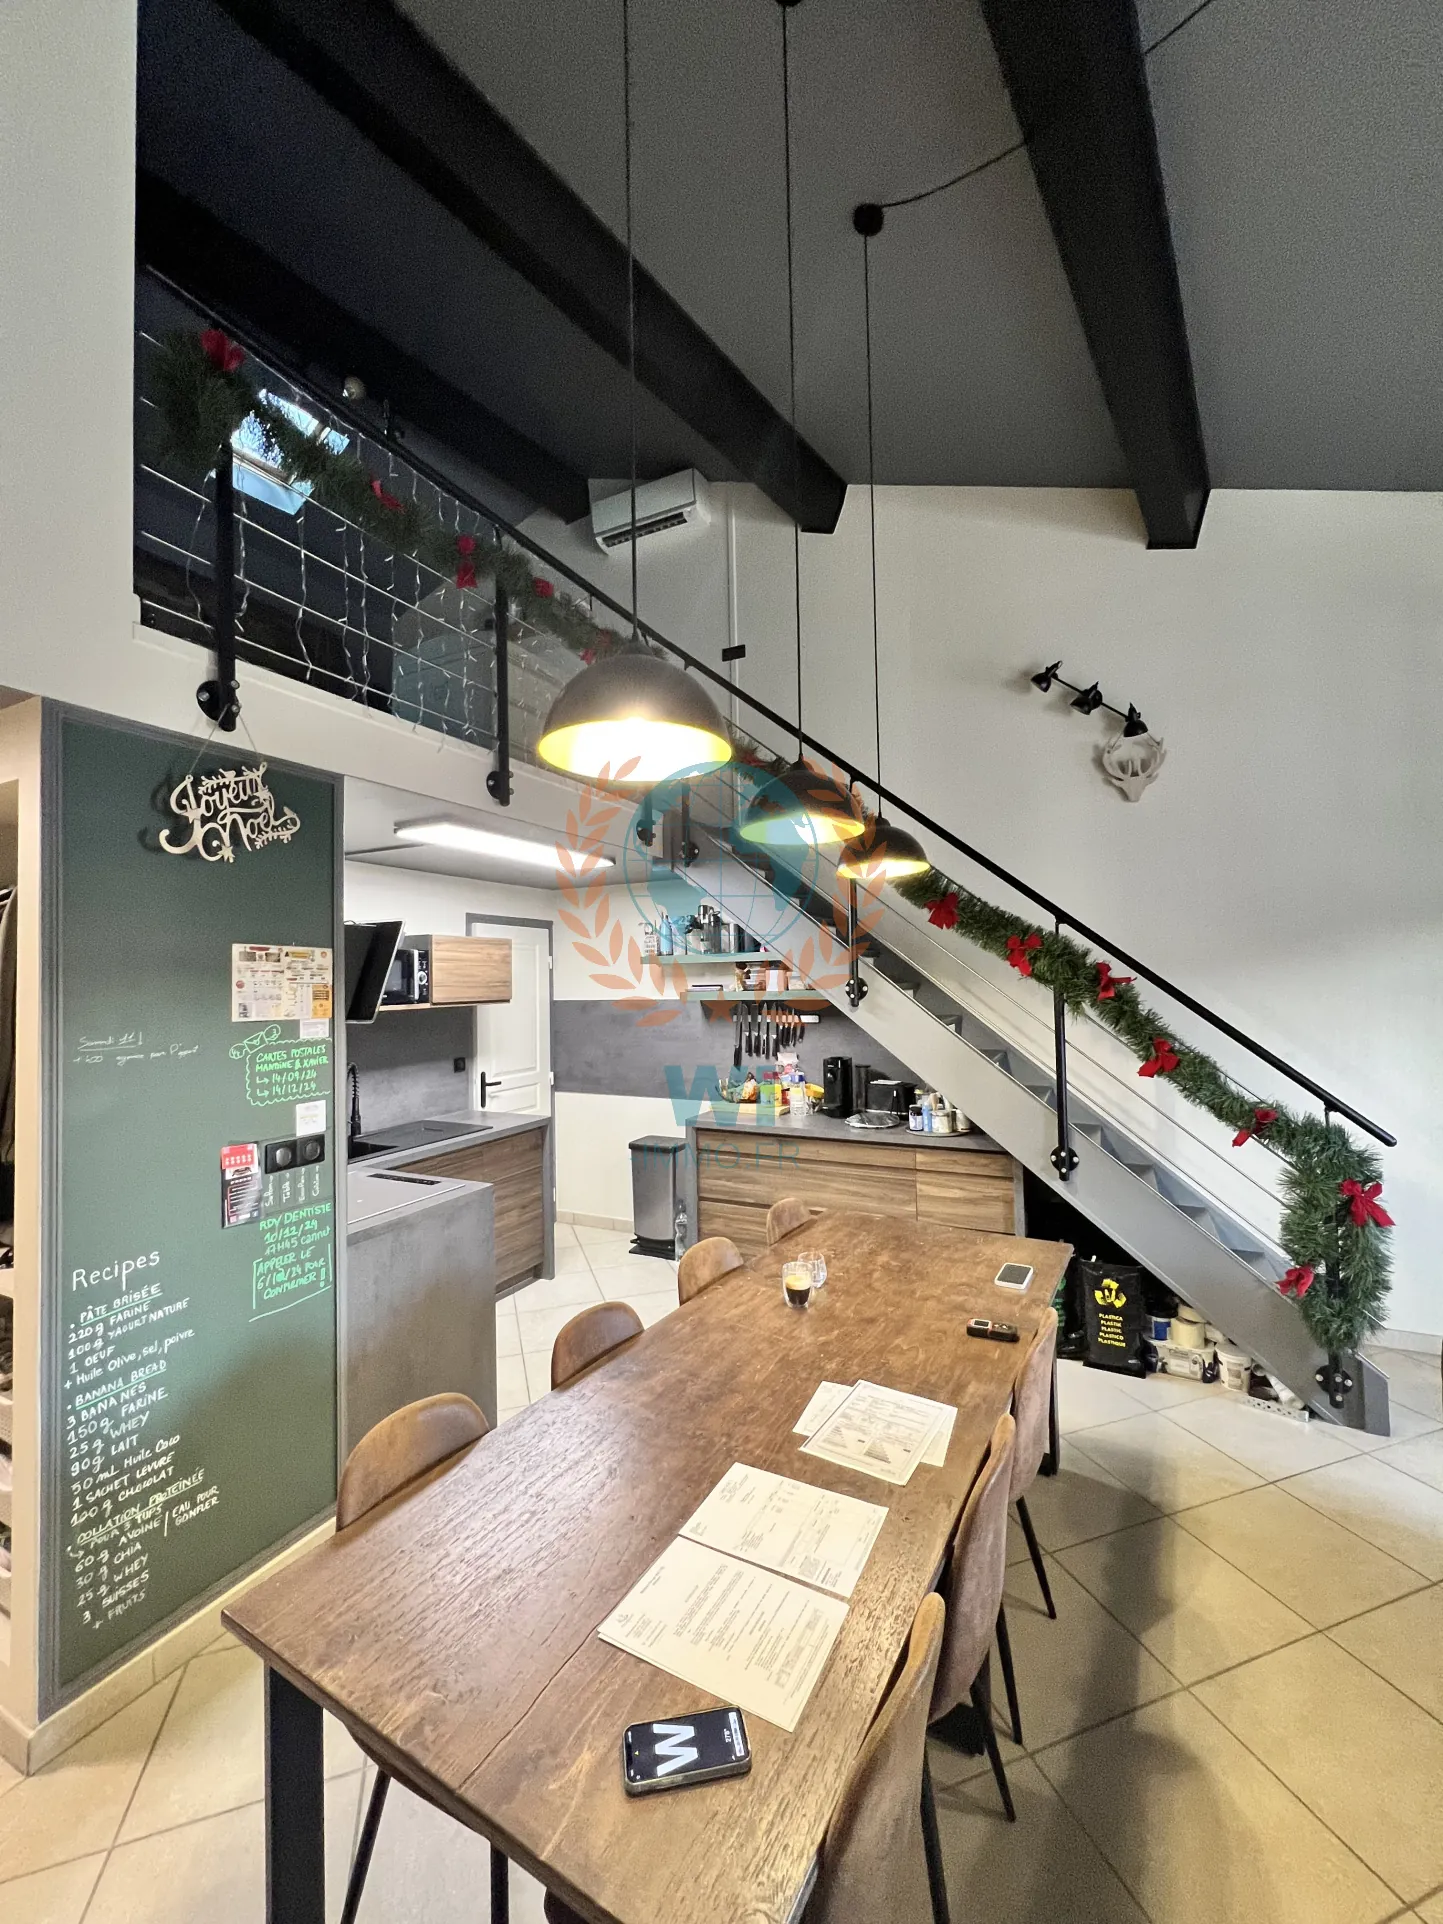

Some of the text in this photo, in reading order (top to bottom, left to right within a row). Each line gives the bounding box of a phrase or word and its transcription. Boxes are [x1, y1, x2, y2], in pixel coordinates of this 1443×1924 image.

[256, 1050, 287, 1063] CARTES
[291, 1044, 326, 1058] POSTALES
[302, 1055, 329, 1068] XAVIER
[272, 1081, 316, 1096] 14/12/24
[284, 1202, 332, 1225] DENTISTE
[72, 1250, 161, 1292] Recipes
[256, 1245, 316, 1277] APPELER LE
[80, 1282, 161, 1323] PÂTE BRISÉE
[109, 1300, 151, 1326] FARINE
[108, 1315, 148, 1340] YAOURT
[148, 1297, 190, 1323] NATURE
[76, 1367, 104, 1385] Huile
[164, 1329, 196, 1354] poivre
[84, 1345, 116, 1366] OEUF
[75, 1360, 167, 1407] BANANA BREAD
[121, 1387, 169, 1417] FARINE
[66, 1415, 76, 1430] 3
[110, 1410, 150, 1439] WHEY
[111, 1434, 139, 1456] LAIT
[124, 1448, 153, 1468] Huile
[85, 1473, 130, 1503] SACHET
[136, 1451, 176, 1479] LEVURE
[118, 1465, 175, 1502] CHOCOLAT
[172, 1485, 220, 1518] EAU POUR
[175, 1496, 220, 1527] GONFLER
[77, 1503, 141, 1545] COLLATION
[90, 1527, 119, 1549] POUR
[118, 1514, 163, 1547] AVOINE
[113, 1542, 142, 1565] CHIA
[113, 1552, 149, 1583] WHEY
[82, 1569, 150, 1625] 3 SUISSES
[107, 1587, 147, 1621] FRUITS
[652, 1723, 699, 1777] W
